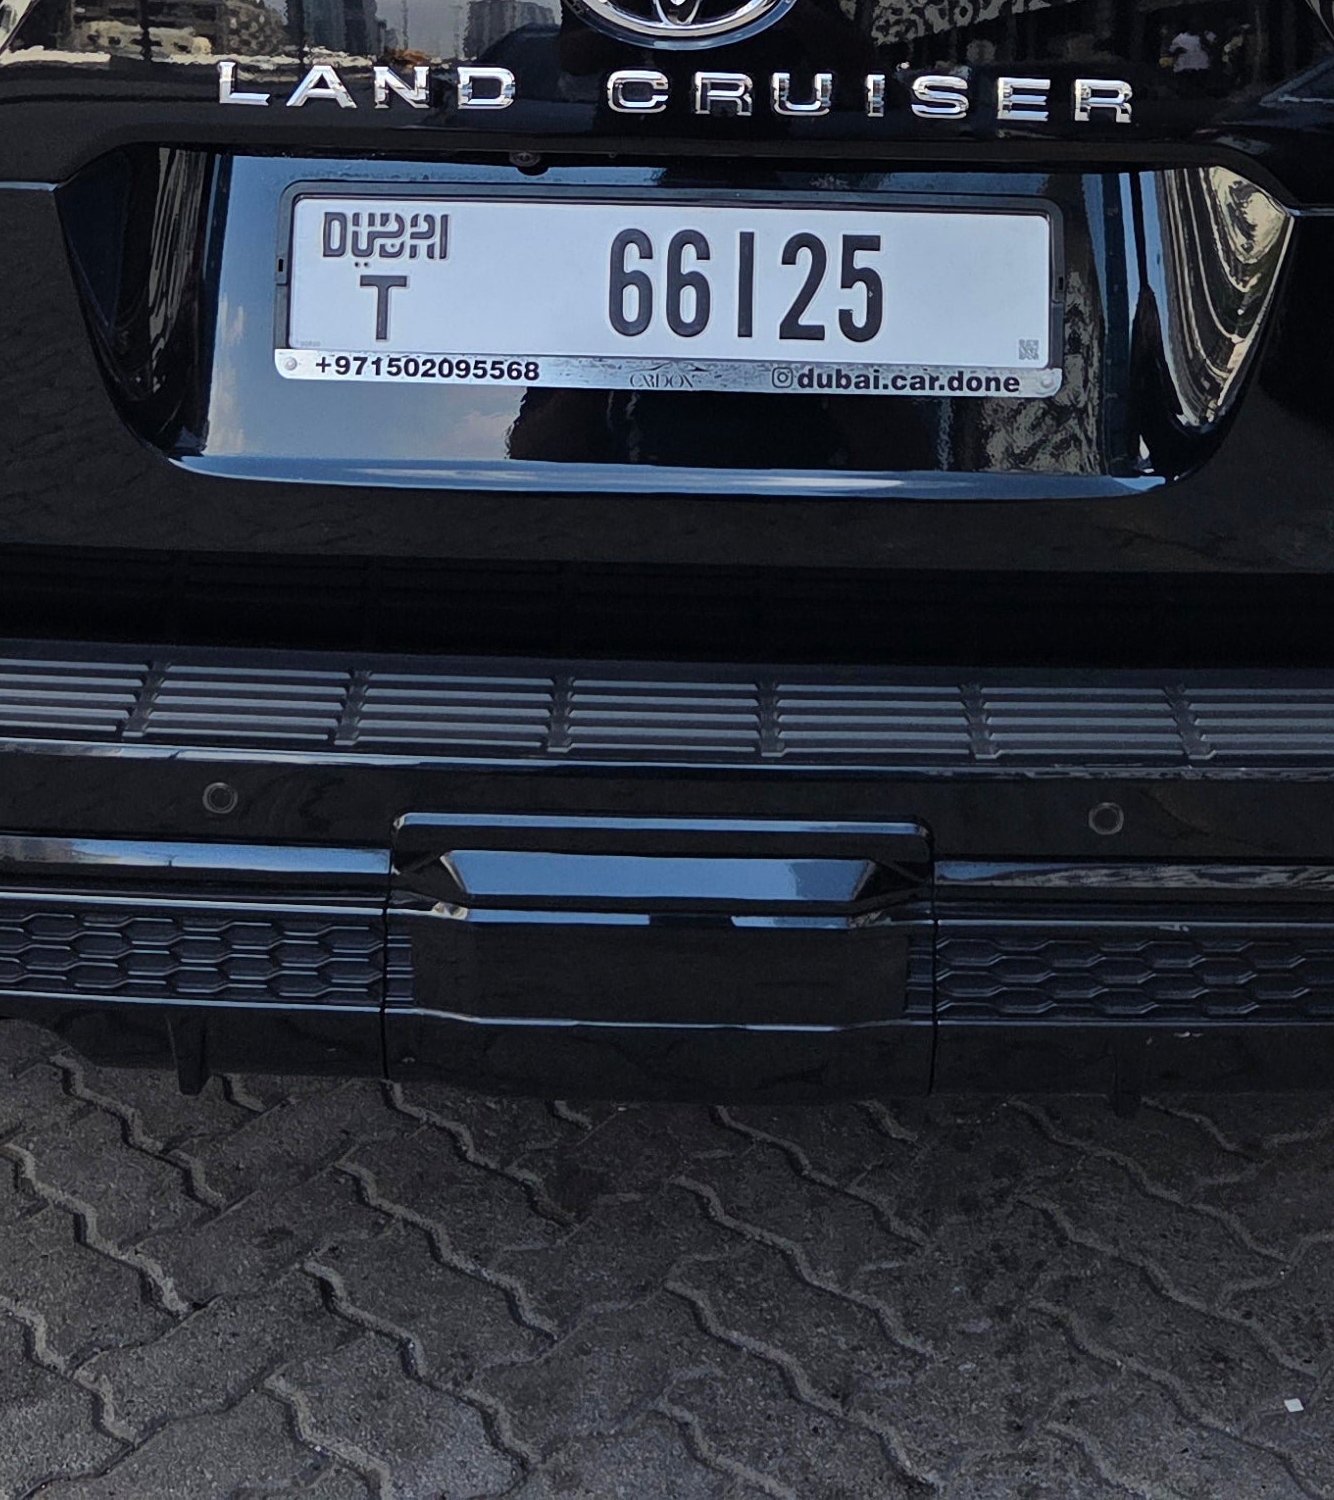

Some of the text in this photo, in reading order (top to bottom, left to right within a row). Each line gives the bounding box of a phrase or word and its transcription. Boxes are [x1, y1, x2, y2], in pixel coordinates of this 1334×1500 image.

[217, 61, 1134, 124] LAND CRUISER
[359, 274, 408, 341] T
[608, 227, 884, 343] 66125
[315, 355, 540, 382] +971502095568
[797, 368, 1022, 393] dubai.car.done
